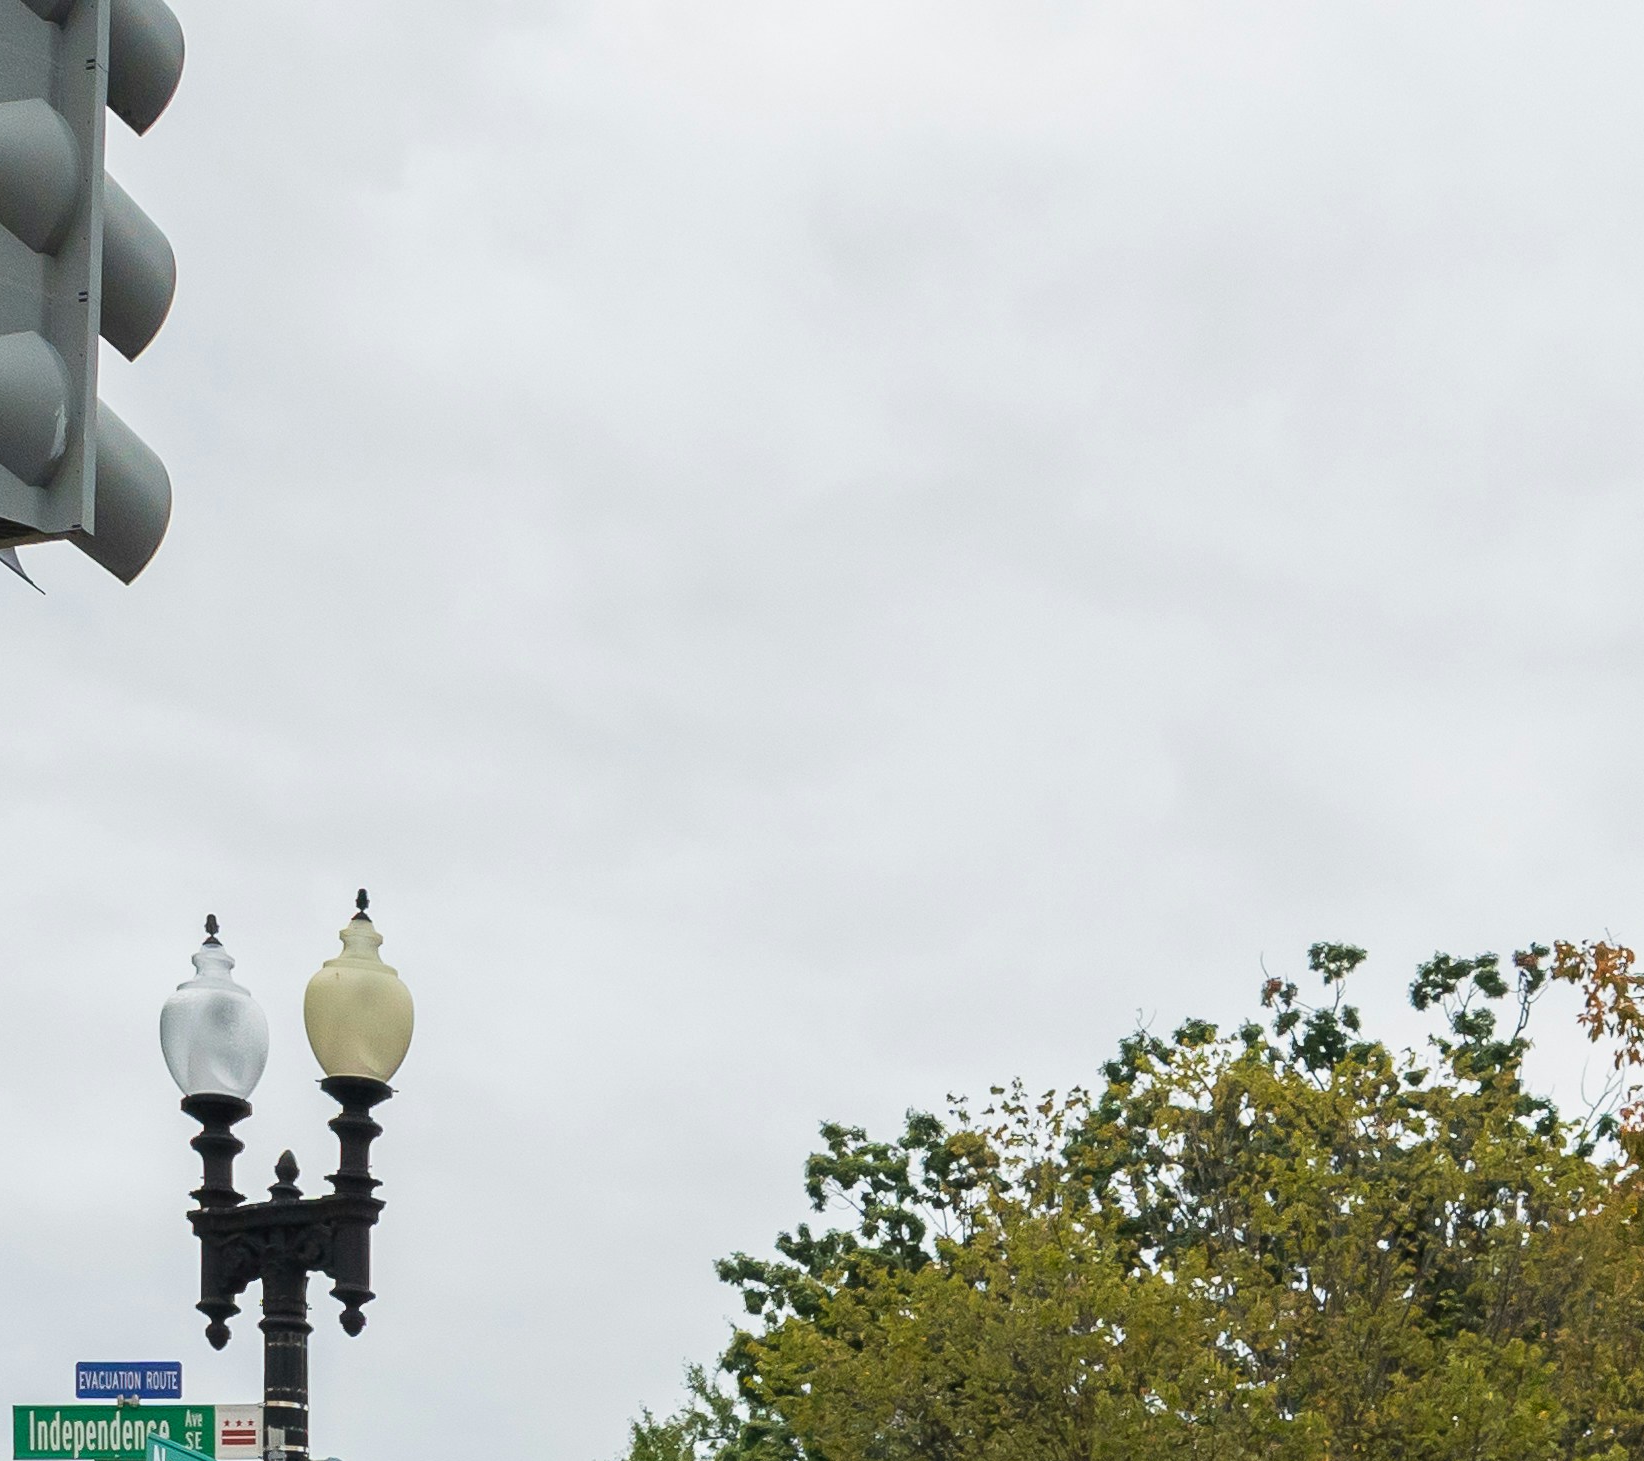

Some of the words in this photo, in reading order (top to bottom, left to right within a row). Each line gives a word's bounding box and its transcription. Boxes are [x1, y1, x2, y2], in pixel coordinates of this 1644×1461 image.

[79, 1371, 141, 1391] EVACUATION
[146, 1370, 178, 1390] ROUTE
[184, 1410, 203, 1428] Ave
[185, 1432, 203, 1450] SE
